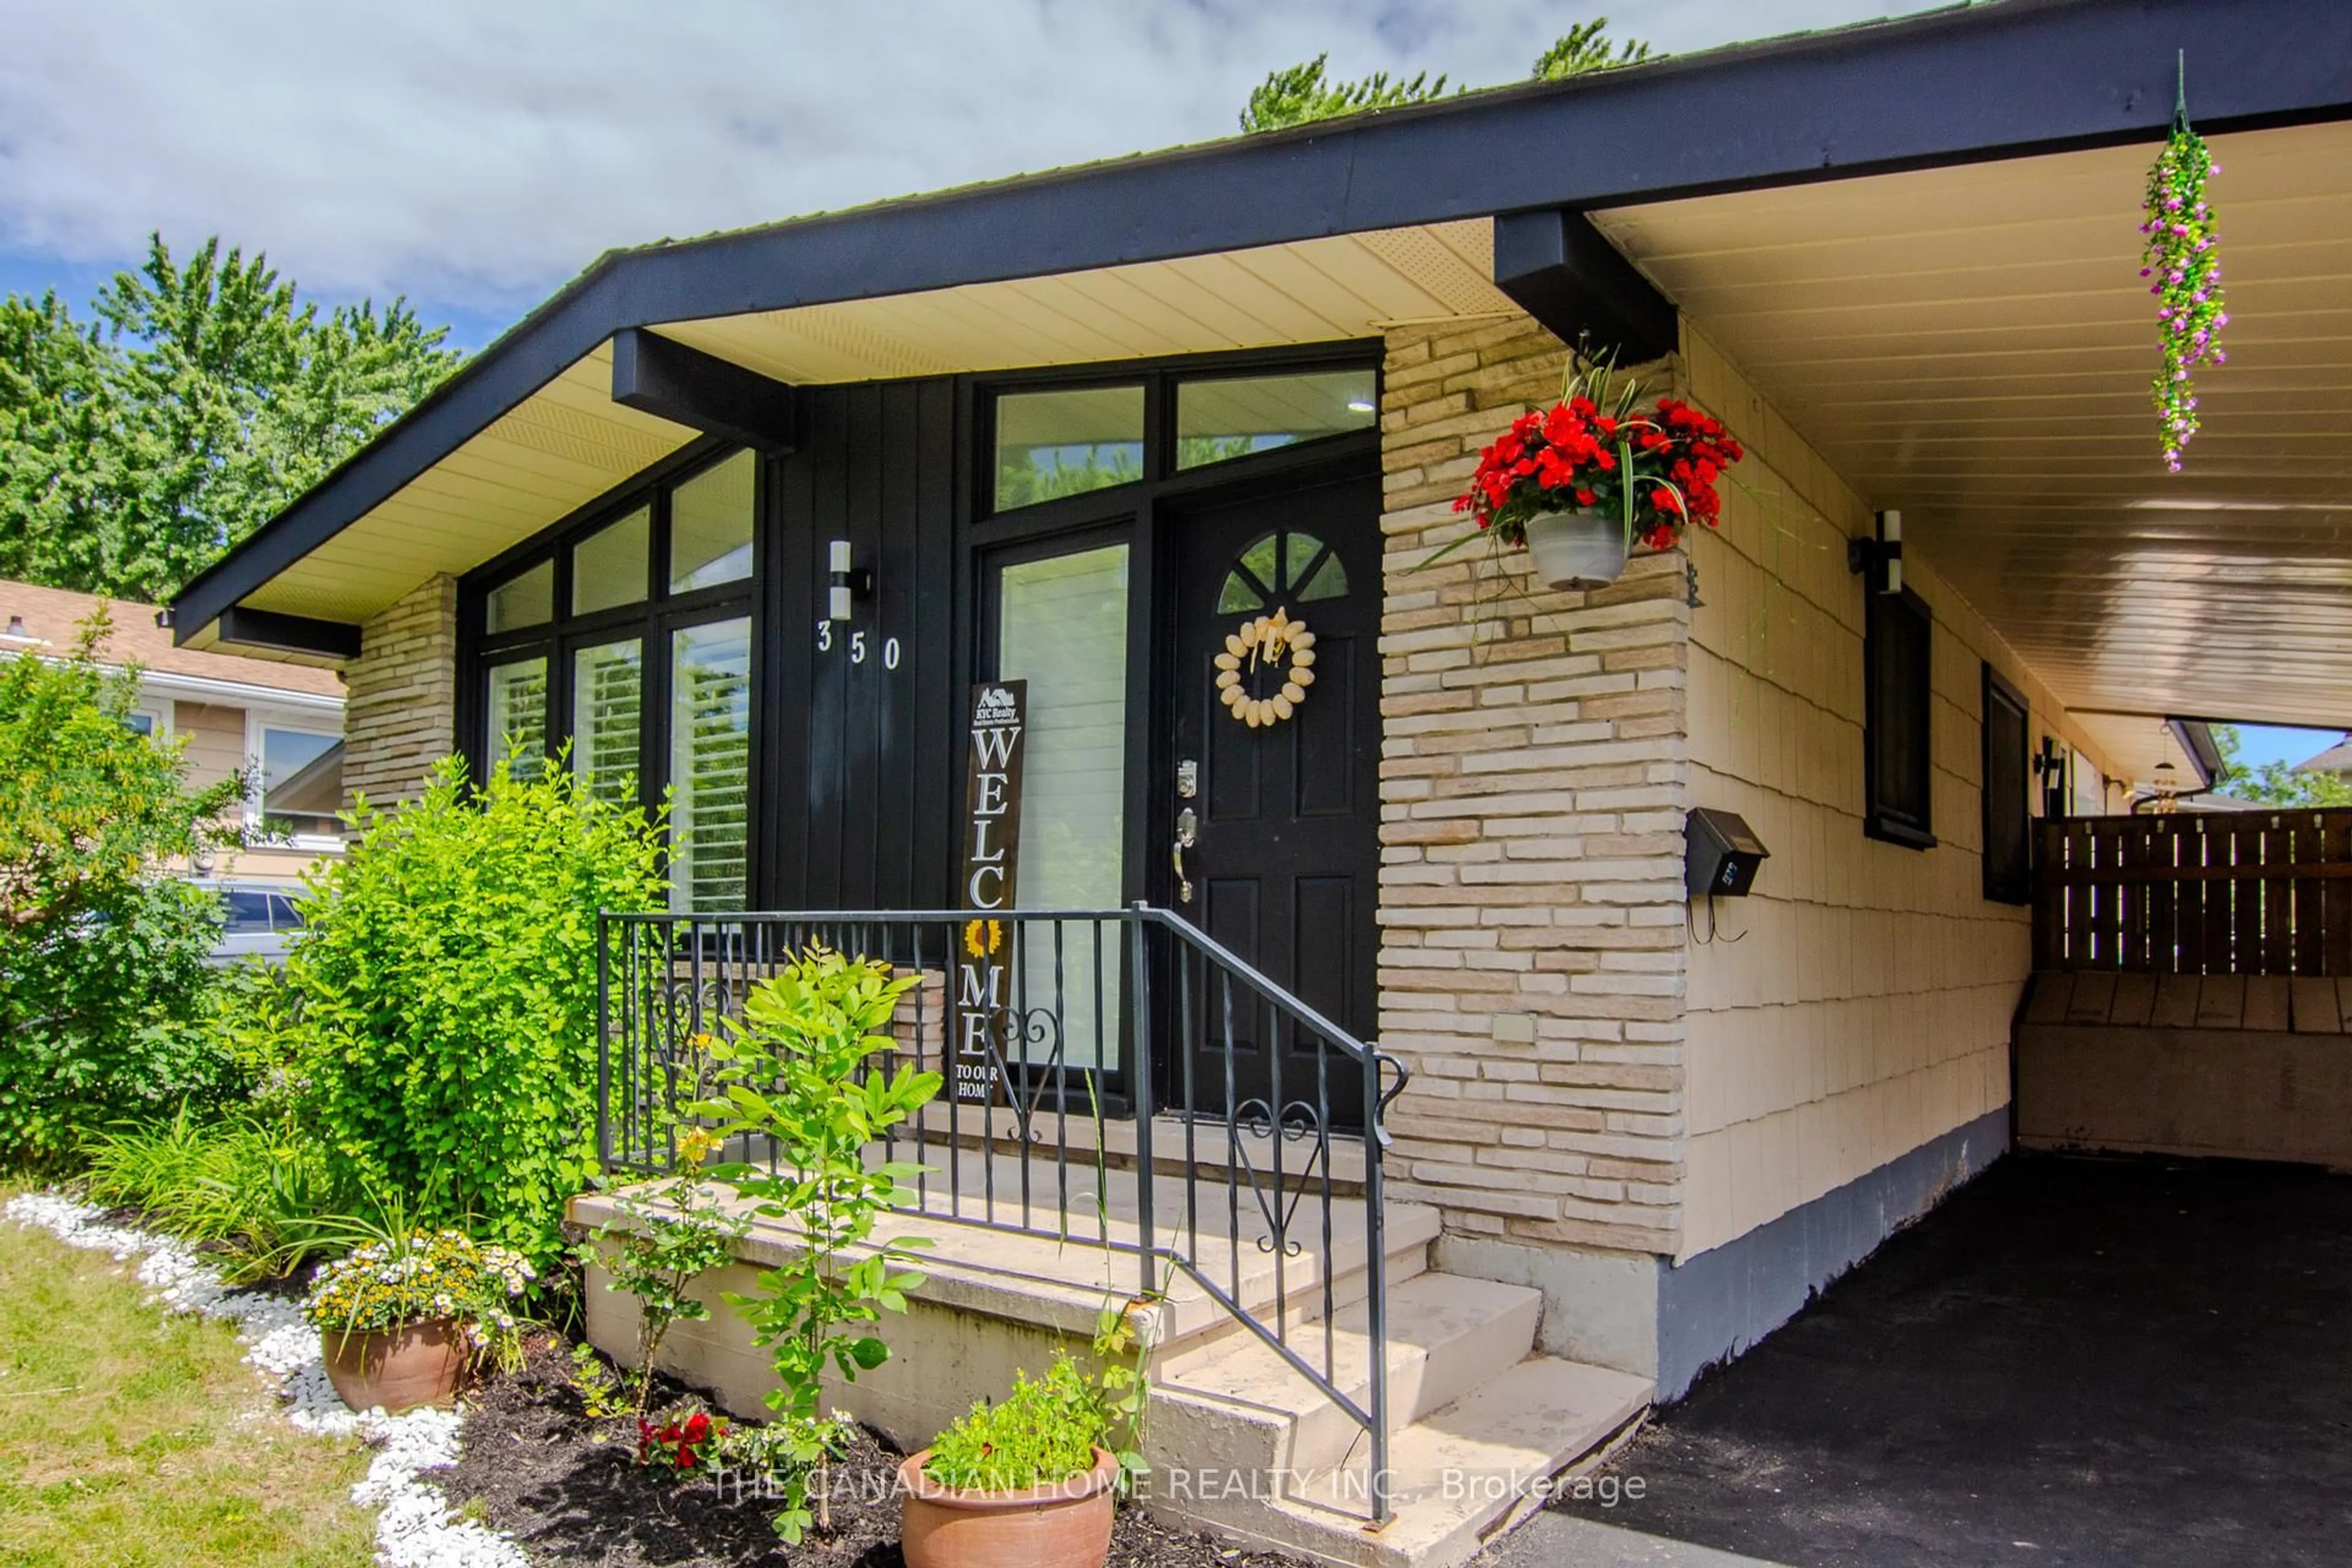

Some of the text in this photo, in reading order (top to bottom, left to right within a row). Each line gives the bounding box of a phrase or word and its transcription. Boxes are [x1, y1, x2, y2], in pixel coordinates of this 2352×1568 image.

[992, 706, 1016, 720] Realty
[956, 1065, 972, 1079] TO
[959, 1082, 993, 1098] HOM
